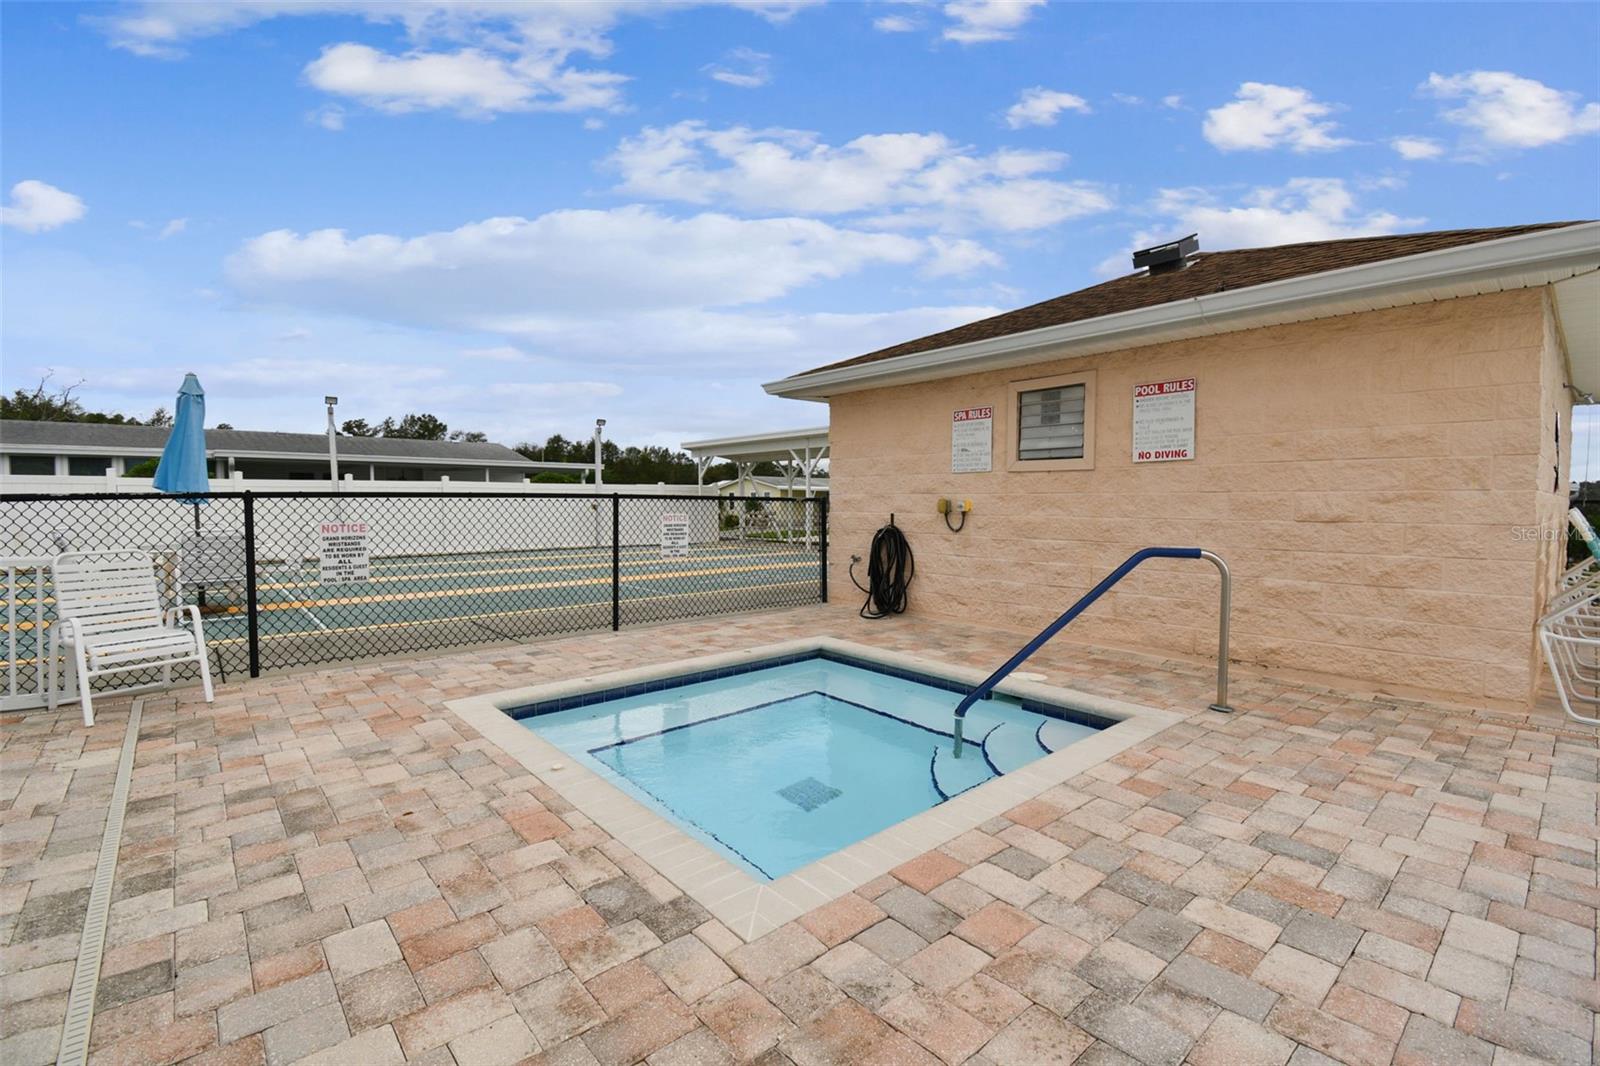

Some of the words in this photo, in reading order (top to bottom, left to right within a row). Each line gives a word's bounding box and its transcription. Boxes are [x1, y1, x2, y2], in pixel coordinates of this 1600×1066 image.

[1135, 384, 1161, 396] POOL
[1163, 380, 1194, 392] RULES
[954, 411, 967, 421] SPA
[968, 408, 991, 419] RULES
[1138, 450, 1151, 460] NO
[1155, 449, 1188, 459] DIVING
[663, 514, 687, 522] NOTICE
[322, 524, 366, 533] NOTICE
